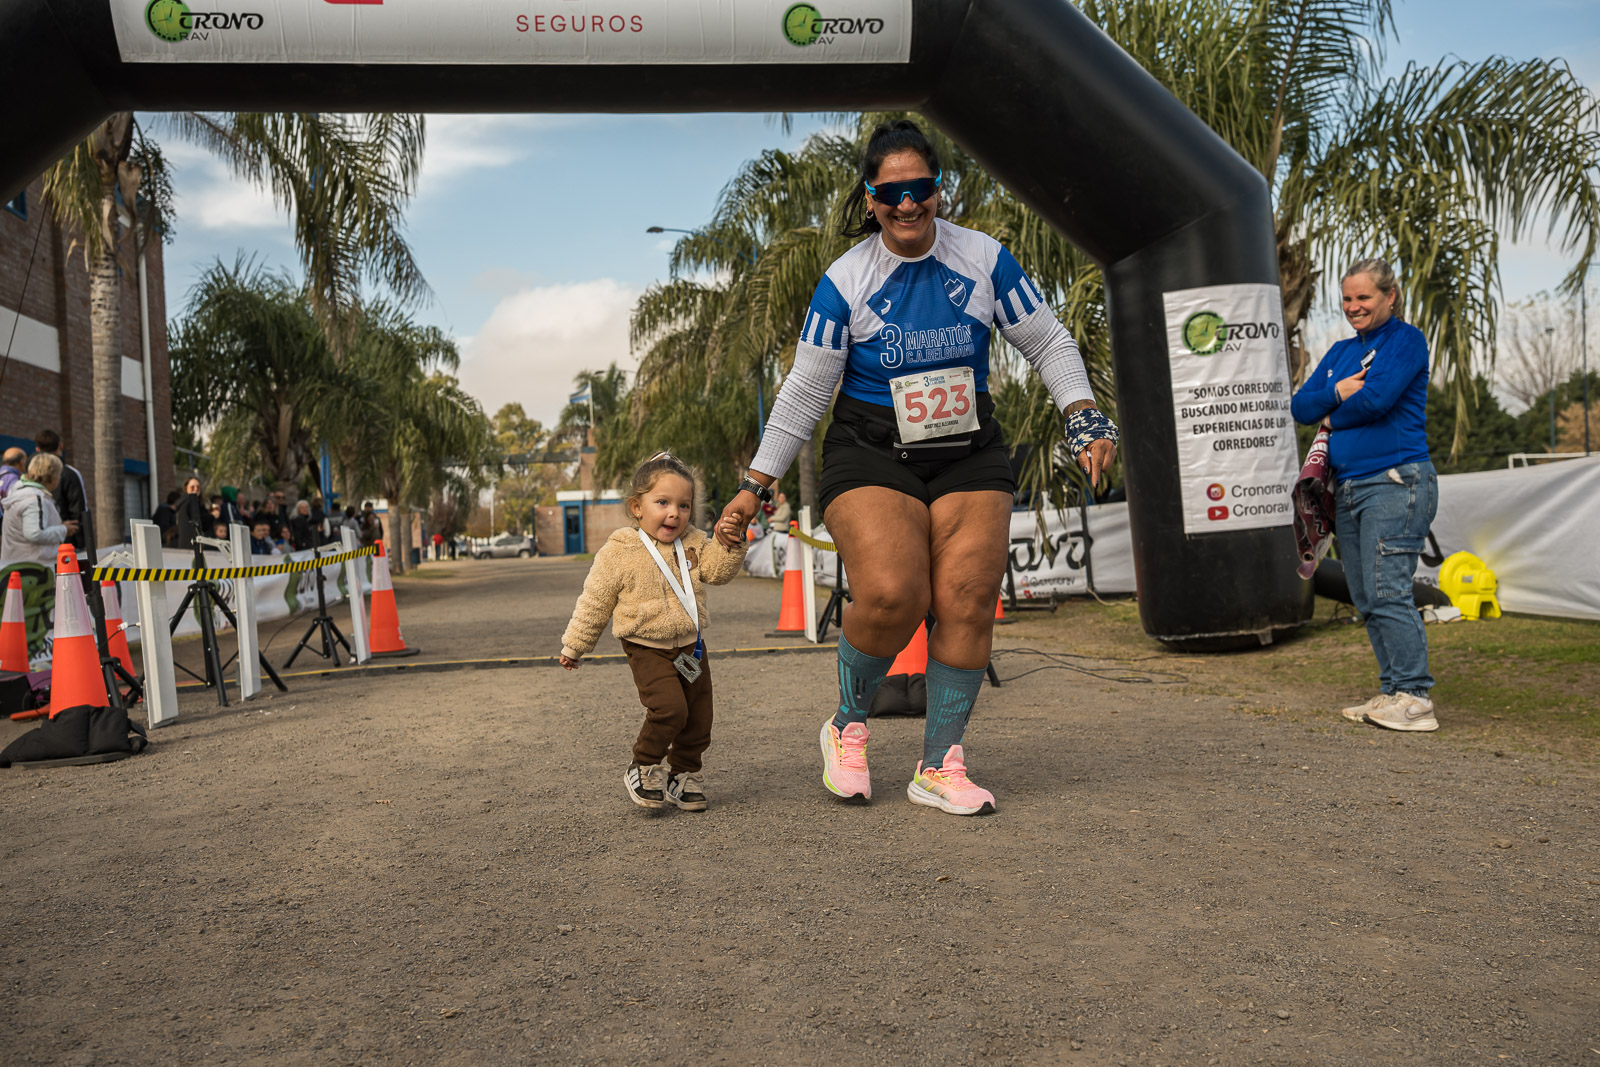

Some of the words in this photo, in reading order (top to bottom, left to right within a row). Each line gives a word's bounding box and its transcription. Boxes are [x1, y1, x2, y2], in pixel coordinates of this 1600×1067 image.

[179, 12, 264, 31] CRONO
[516, 14, 644, 33] SEGUROS
[810, 17, 885, 35] CRONO
[180, 31, 210, 41] RAV
[809, 36, 835, 46] RAV
[904, 322, 973, 351] MARATÓN
[1215, 322, 1280, 342] CRONO
[880, 323, 904, 369] 3
[1214, 343, 1242, 353] RAV
[1232, 381, 1283, 396] CORREDORES
[904, 383, 970, 424] 523
[1181, 402, 1238, 419] BUSCANDO
[1240, 400, 1279, 413] MEJORAR
[1192, 418, 1263, 435] EXPERIENCIAS
[1264, 418, 1275, 429] DE
[1276, 417, 1287, 429] LOS
[1231, 483, 1289, 498] Cronorav
[1232, 503, 1290, 518] Cronorav
